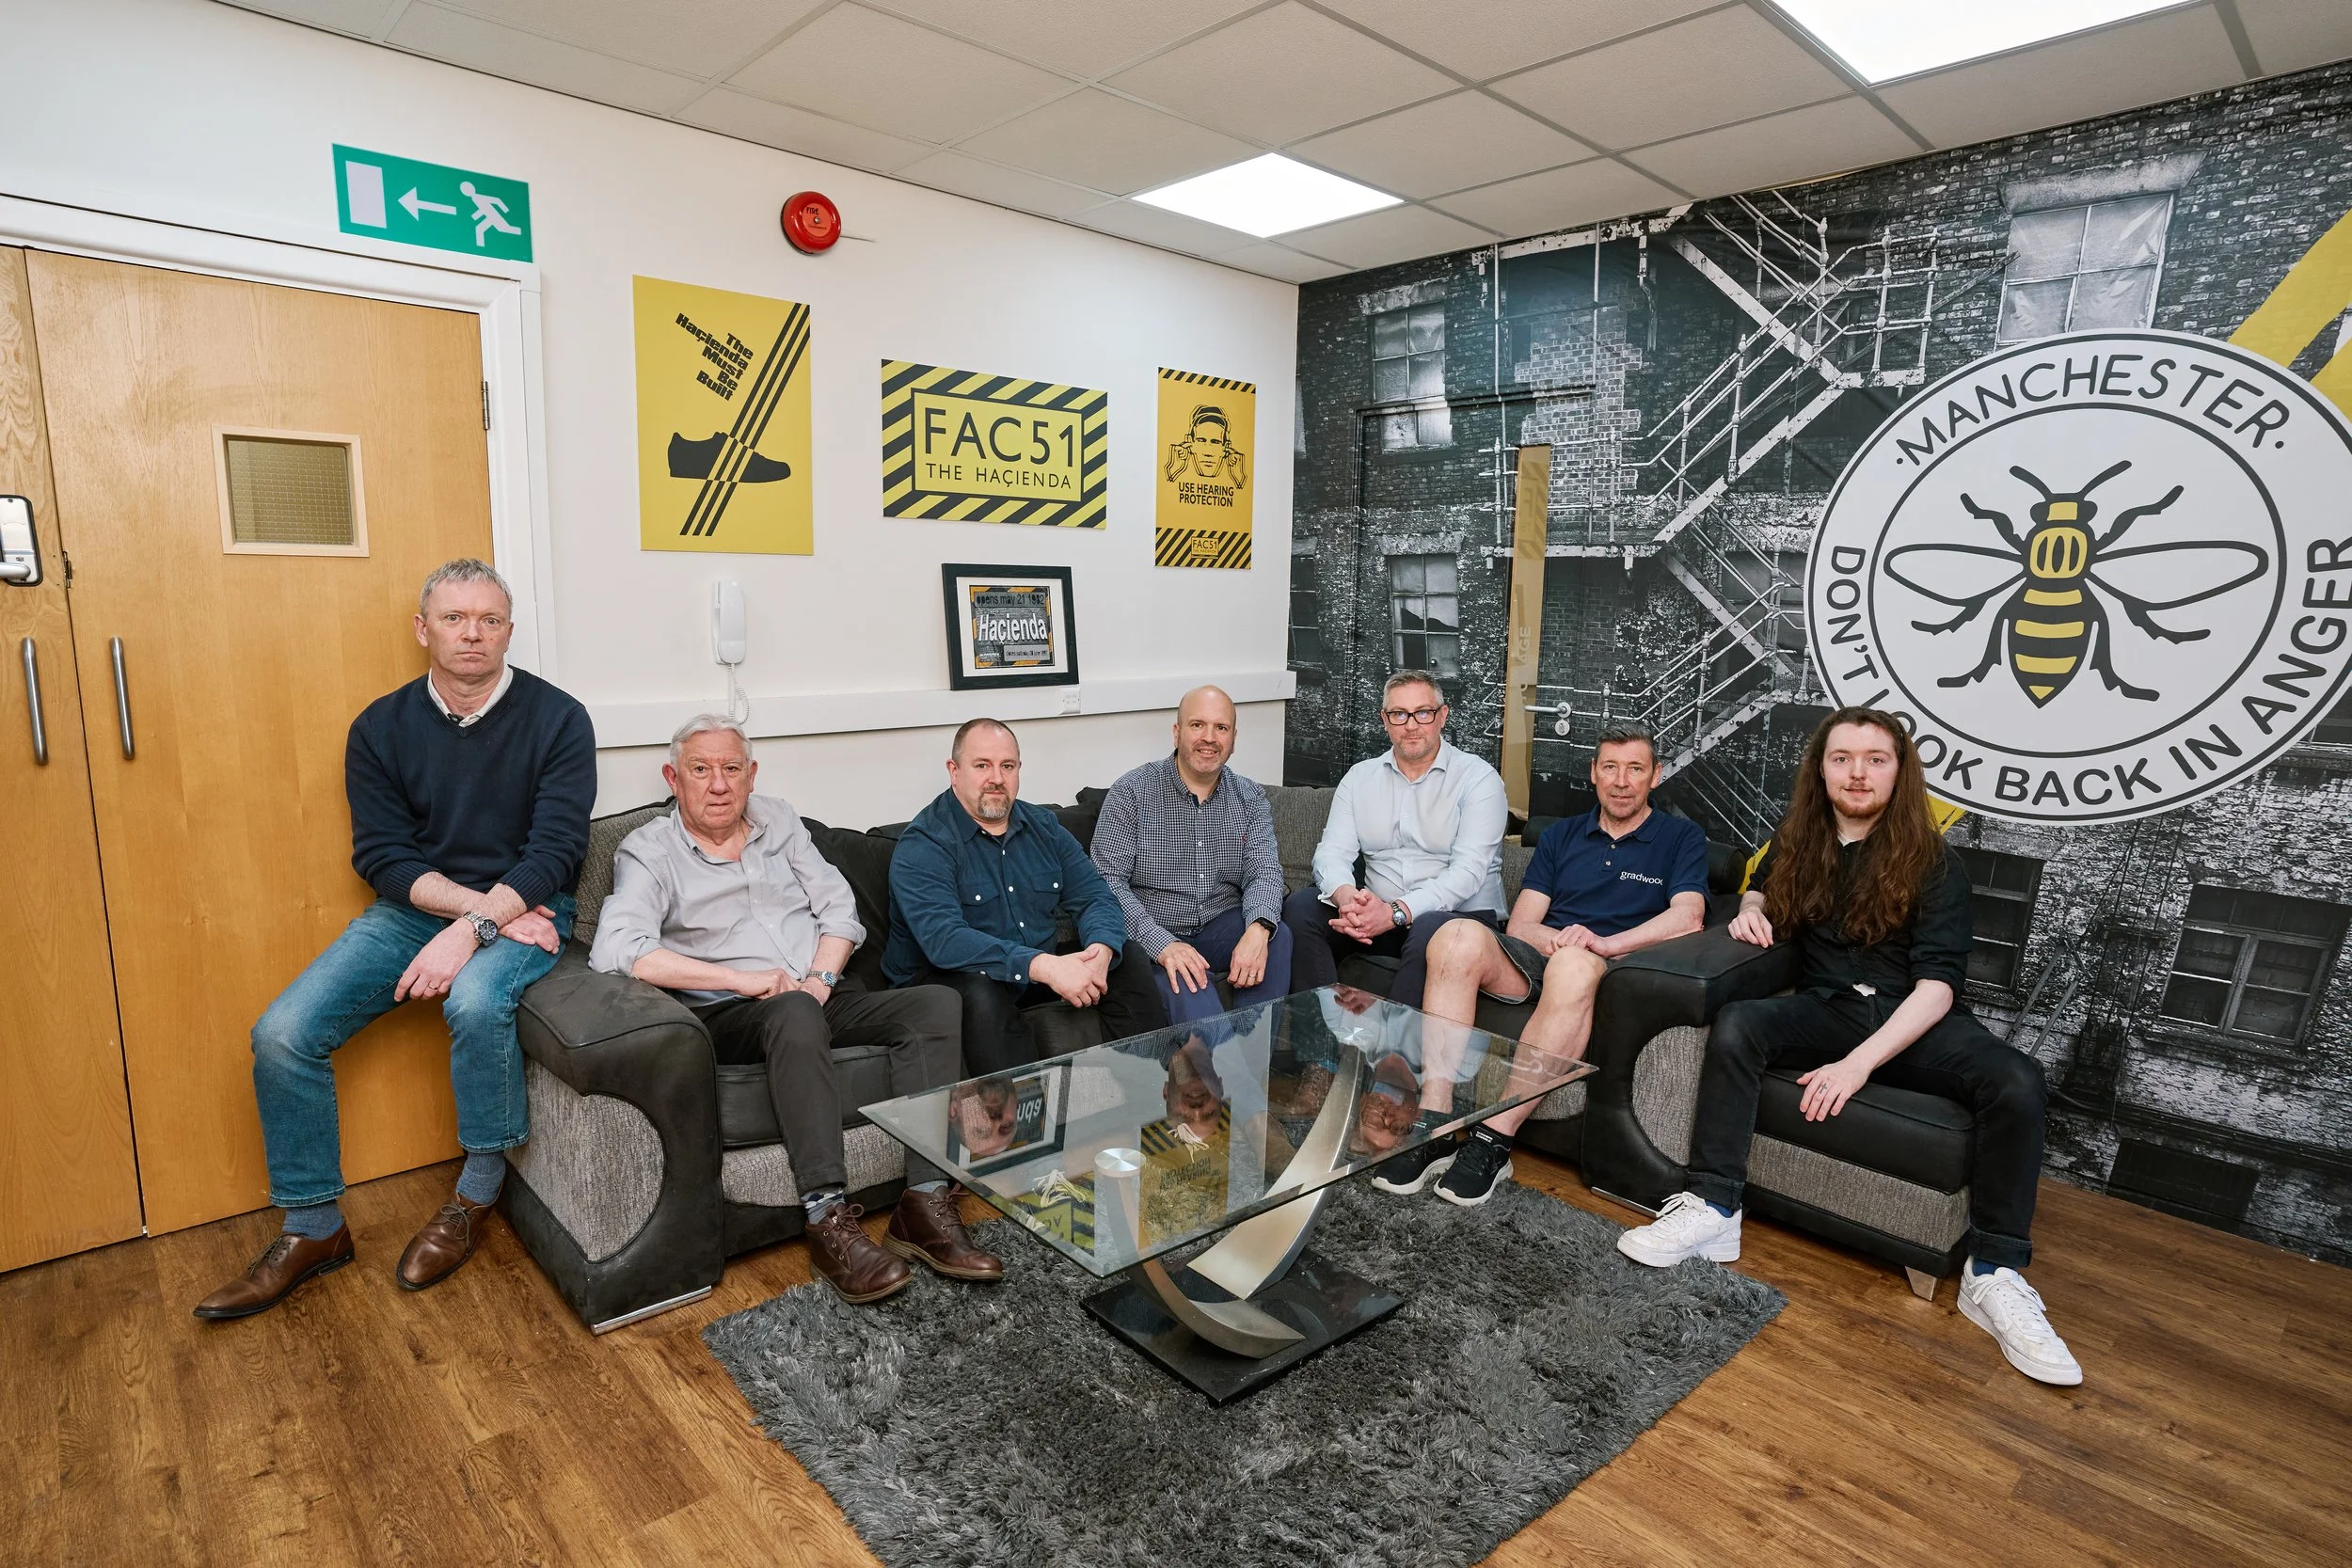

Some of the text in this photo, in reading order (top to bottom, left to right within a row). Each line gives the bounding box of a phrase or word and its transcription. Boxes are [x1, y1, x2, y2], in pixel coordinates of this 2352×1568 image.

[806, 207, 819, 215] FIRE
[675, 312, 749, 371] Haçienda
[726, 333, 754, 360] The
[702, 345, 744, 380] Must
[696, 370, 734, 401] Built
[717, 371, 739, 391] Be
[925, 407, 1073, 467] FAC51
[926, 463, 1072, 490] THE HAÇIENDA
[1178, 482, 1234, 497] USE HEARING
[1179, 493, 1233, 508] PROTECTION
[1192, 539, 1217, 550] FAC51
[976, 594, 998, 607] opens
[1000, 594, 1016, 607] may
[1017, 594, 1025, 605] 21
[978, 612, 1048, 645] Haçienda
[1826, 545, 1880, 681] DON'T
[1994, 757, 2162, 807] BACK
[2168, 723, 2243, 780] IN
[2241, 538, 2352, 736] ANGER
